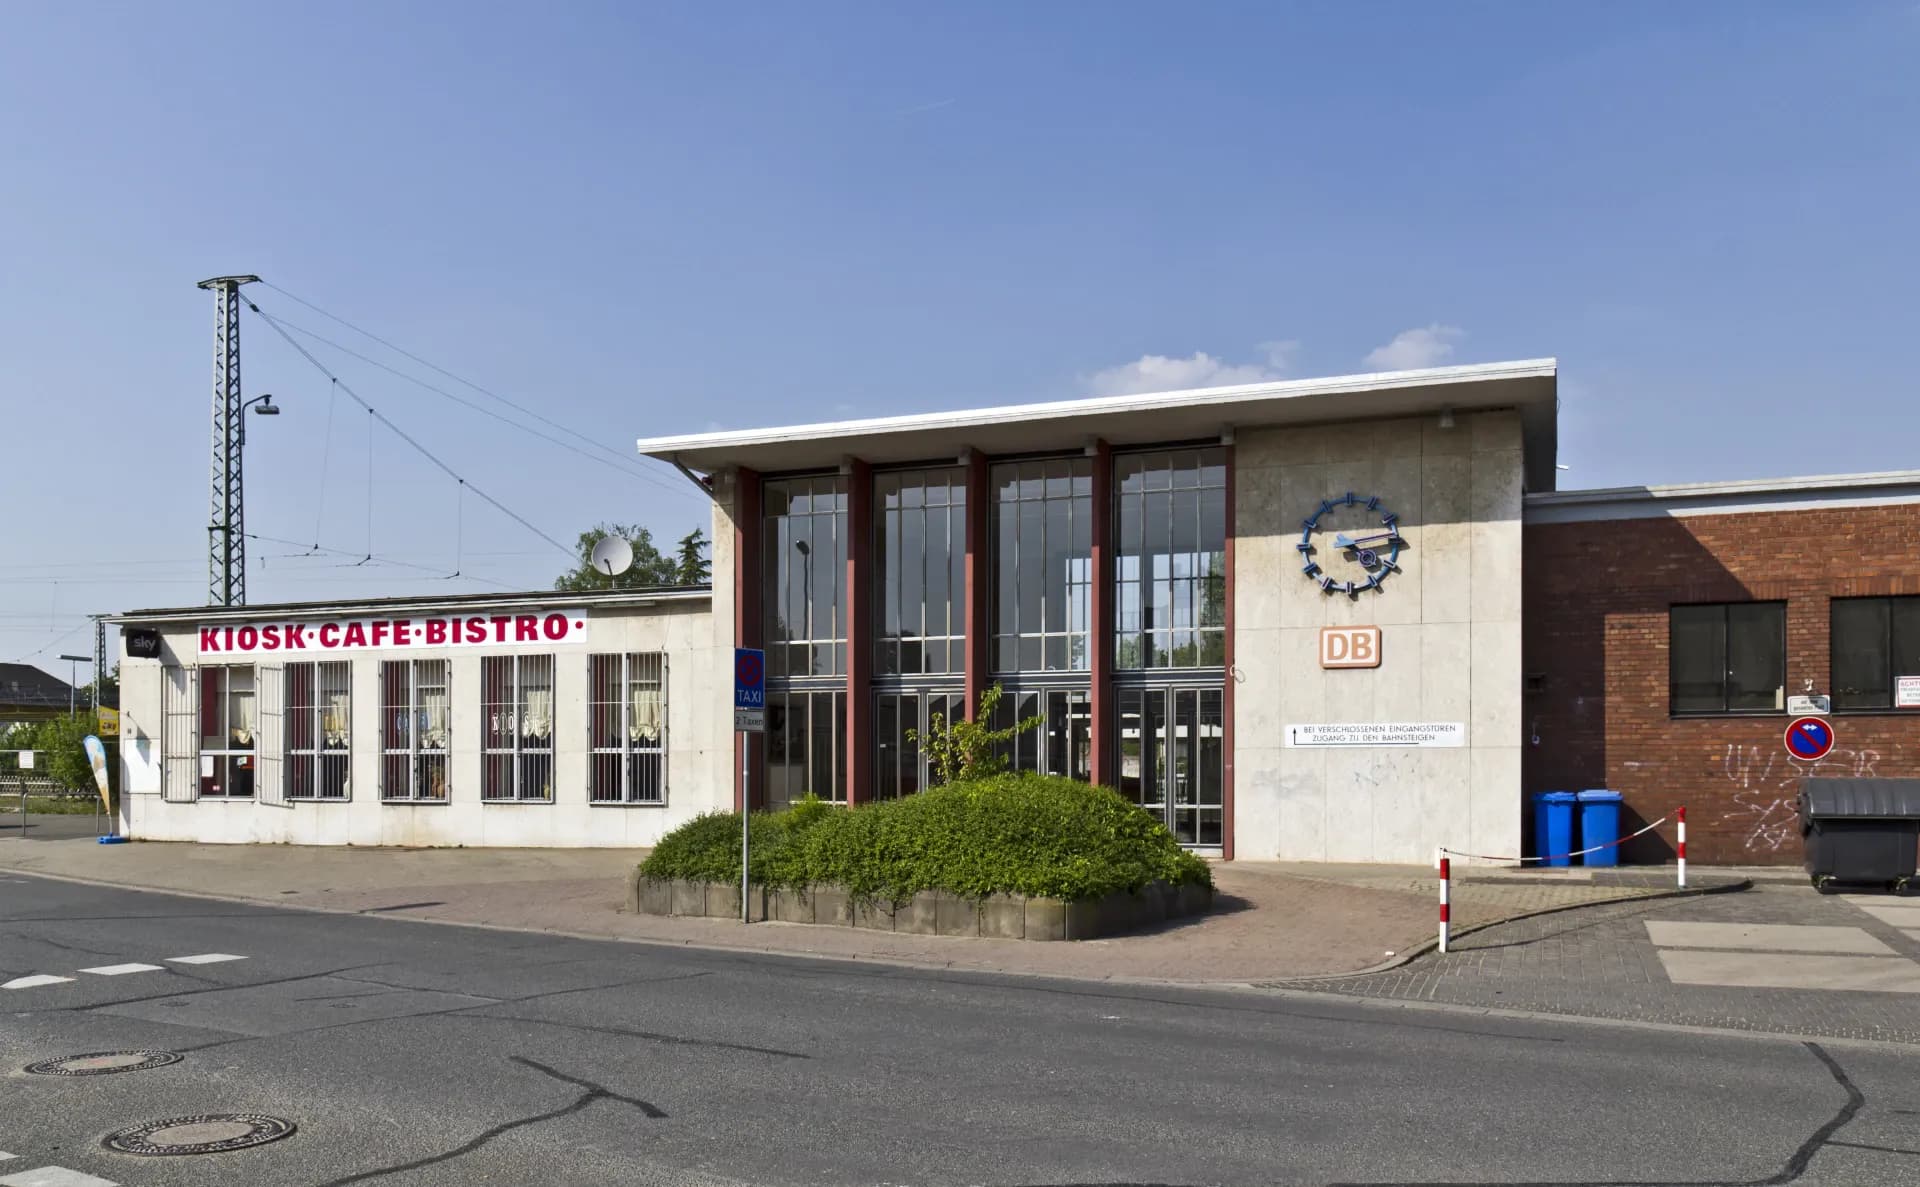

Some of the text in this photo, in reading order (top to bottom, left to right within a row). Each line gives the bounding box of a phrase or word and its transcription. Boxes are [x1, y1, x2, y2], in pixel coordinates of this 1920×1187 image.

[134, 636, 156, 651] sky
[1327, 633, 1372, 660] DB
[737, 689, 762, 703] TAXI
[1319, 725, 1386, 733] VERSCHLOSSENEN
[1312, 734, 1346, 742] ZUGANG
[1363, 734, 1378, 742] DEN
